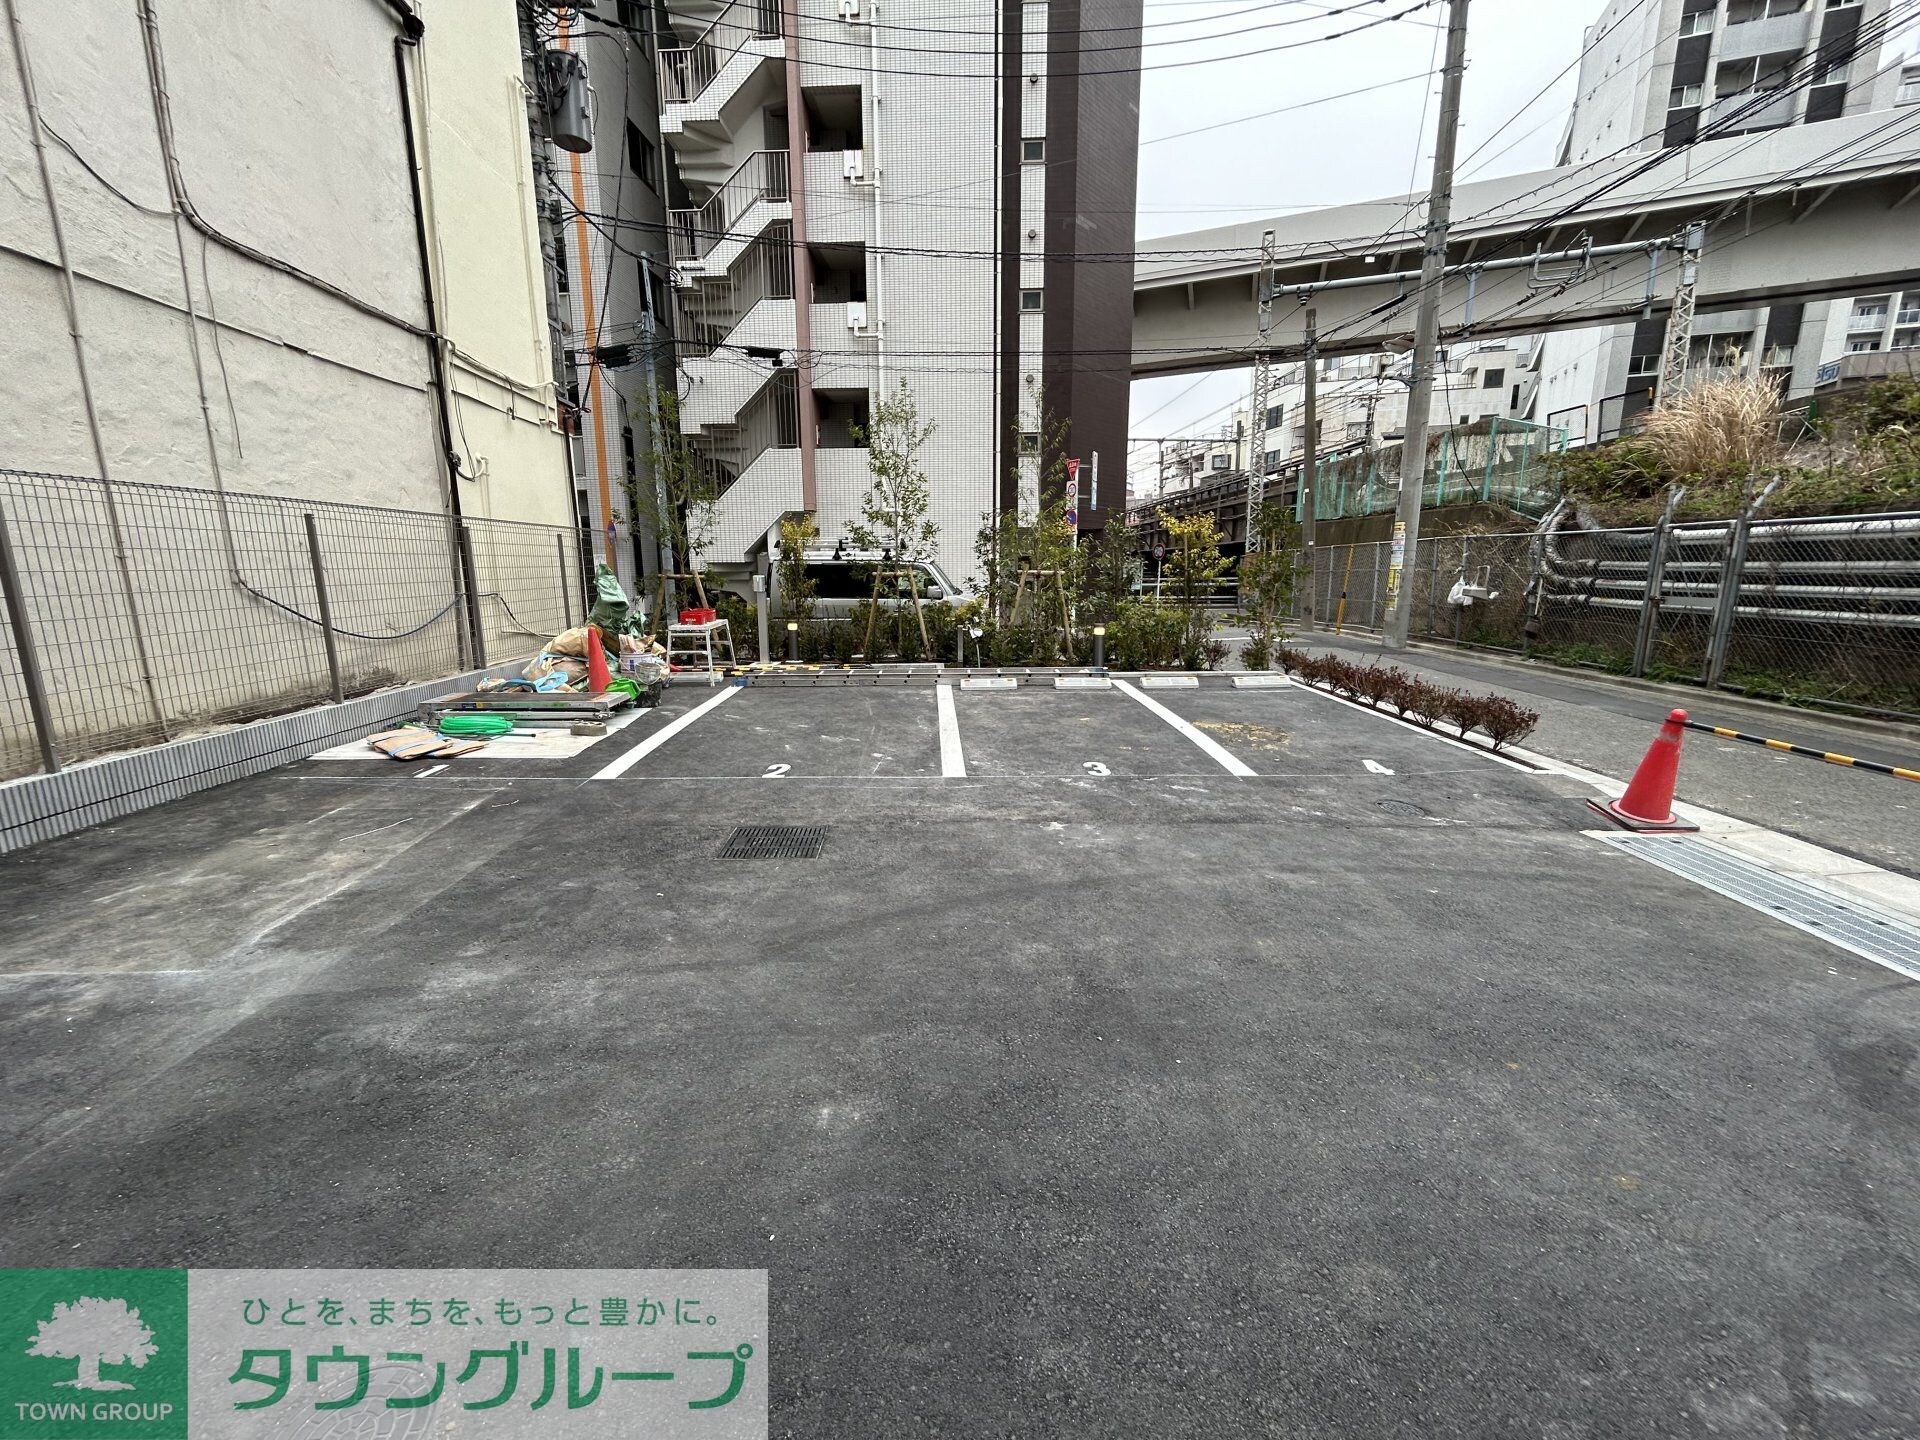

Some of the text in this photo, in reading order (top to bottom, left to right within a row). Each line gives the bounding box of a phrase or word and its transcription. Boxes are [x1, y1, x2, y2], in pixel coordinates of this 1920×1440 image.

[761, 763, 792, 779] 2
[1082, 761, 1112, 776] 3
[1361, 759, 1396, 776] 4
